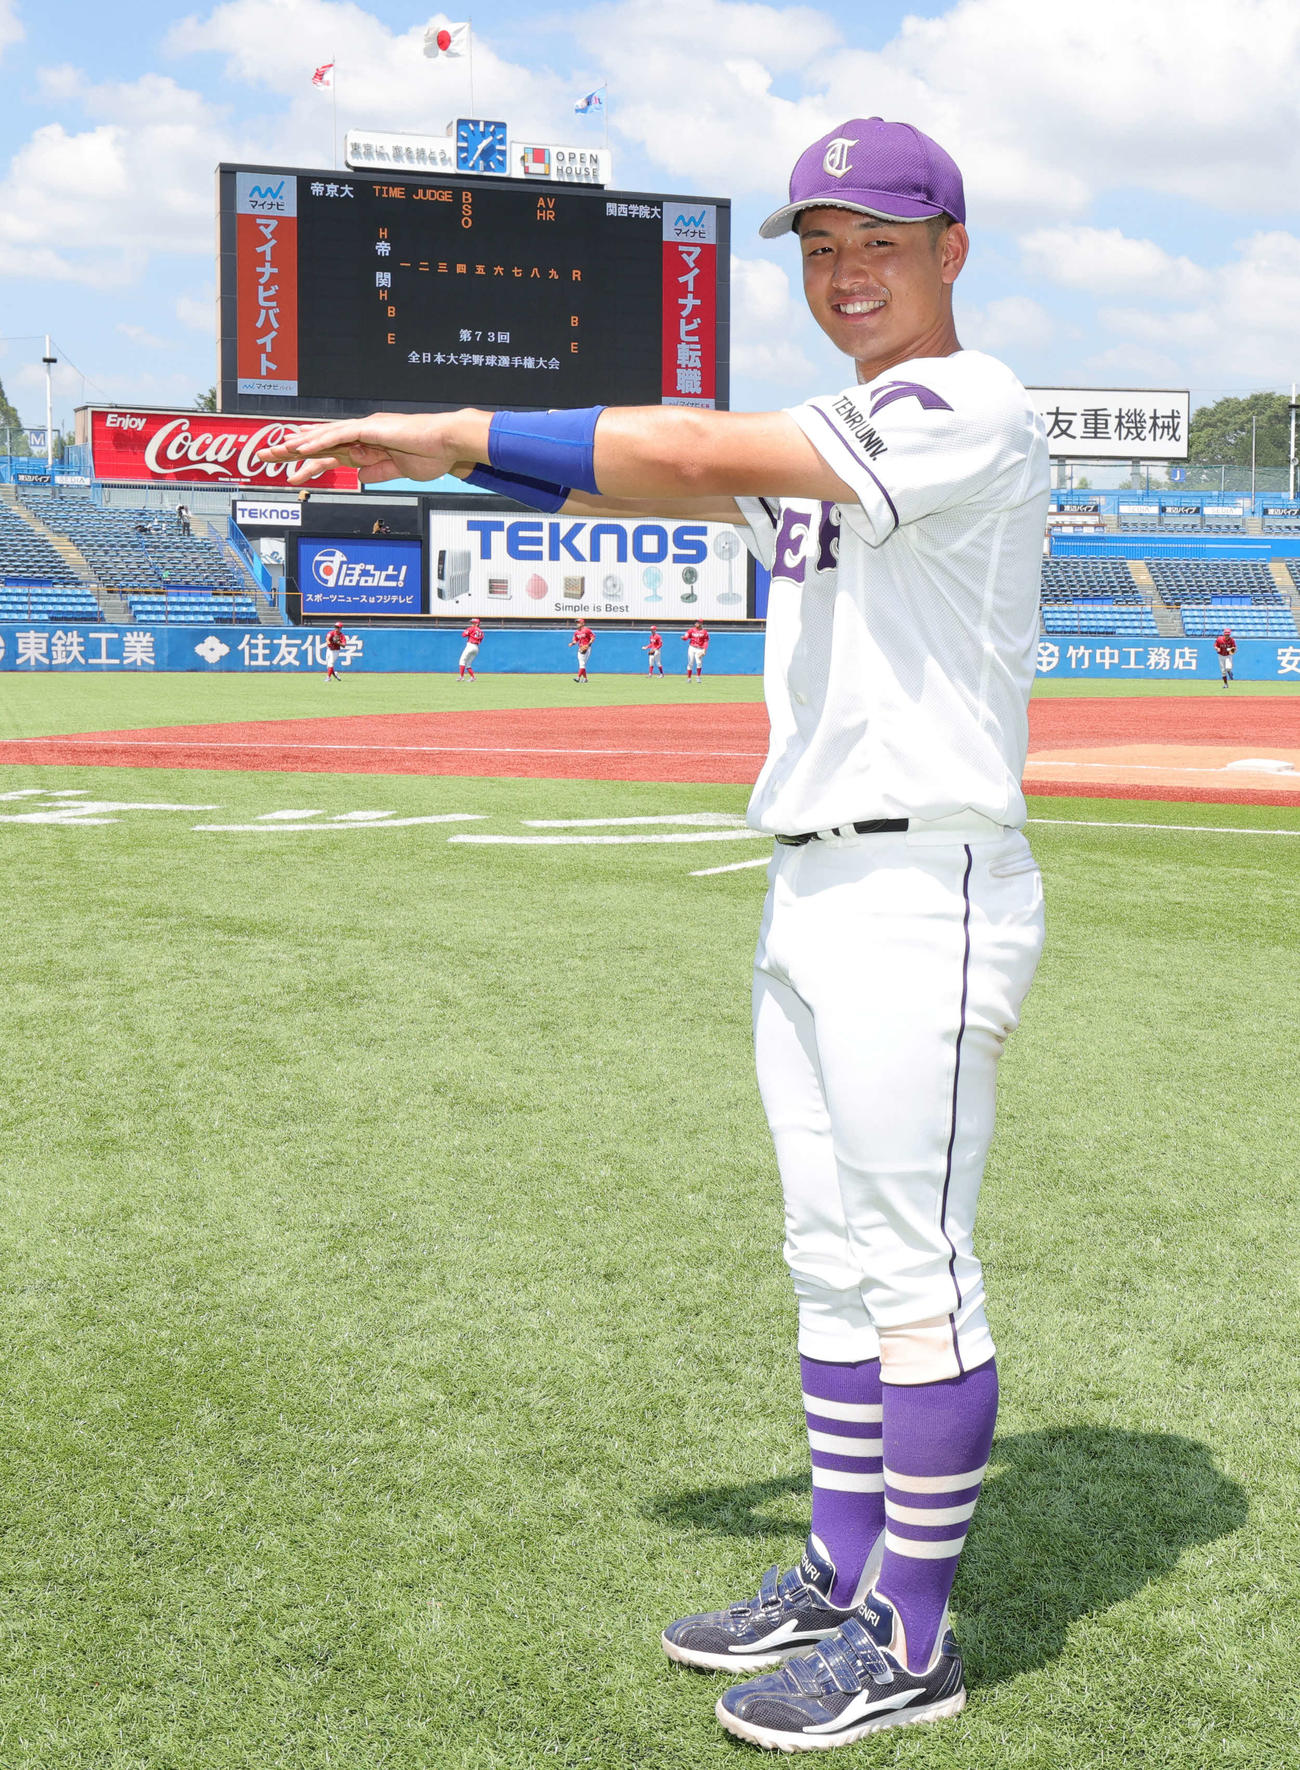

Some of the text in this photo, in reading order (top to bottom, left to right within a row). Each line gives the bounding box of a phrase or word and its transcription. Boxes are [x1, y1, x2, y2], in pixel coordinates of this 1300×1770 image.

[556, 151, 598, 164] OPEN
[822, 138, 860, 179] T
[556, 166, 598, 177] HOUSE
[310, 182, 355, 198] 帝京大
[373, 186, 453, 202] TIME JUDGE
[249, 200, 285, 211] マイナビ
[536, 197, 555, 209] AV
[536, 210, 555, 221] HR
[606, 202, 661, 219] 関西学院大
[379, 228, 388, 239] H
[674, 228, 706, 239] マイナビ
[375, 240, 391, 257] 帝
[375, 272, 391, 288] 関
[572, 269, 582, 281] R
[255, 218, 280, 376] マイナビバイト
[379, 290, 388, 301] H
[387, 306, 396, 318] B
[570, 316, 579, 327] B
[676, 245, 702, 394] マイナビ転職
[387, 333, 396, 344] E
[570, 342, 579, 353] E
[407, 350, 560, 370] 全日本大学野球選手権大会
[832, 395, 888, 461] TENRI UNIV.
[1040, 406, 1181, 442] 友重機械
[31, 433, 44, 446] M
[106, 414, 327, 478] Enjoy Coca-C
[238, 508, 300, 520] TEKNOS
[467, 520, 708, 564] TEKNOS
[306, 593, 414, 604] スポーツニュースはフジテレビ
[554, 602, 629, 613] Simple is Best
[15, 630, 156, 666] 東鉄工業
[237, 633, 364, 666] 住友化学
[1066, 646, 1198, 671] 竹中工務店
